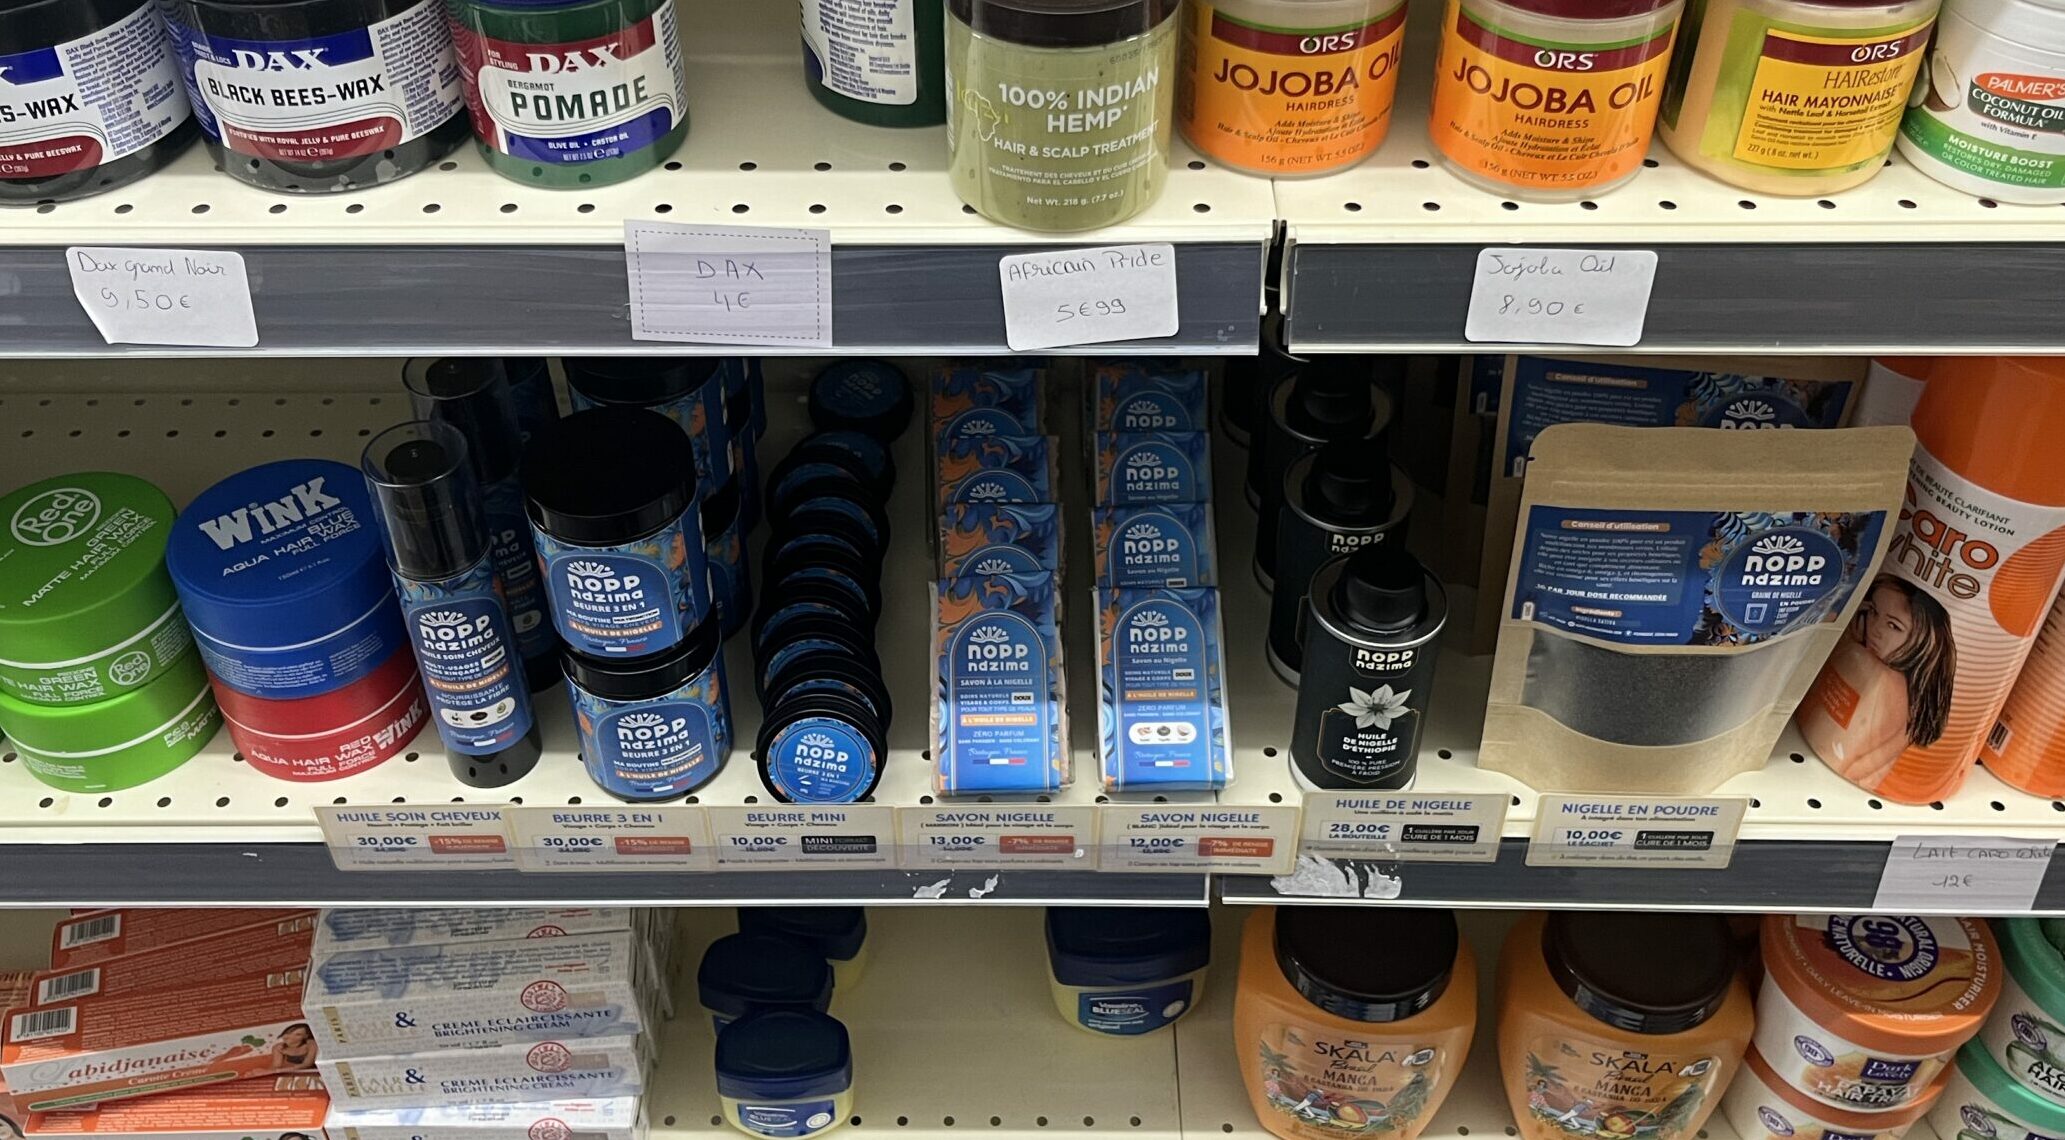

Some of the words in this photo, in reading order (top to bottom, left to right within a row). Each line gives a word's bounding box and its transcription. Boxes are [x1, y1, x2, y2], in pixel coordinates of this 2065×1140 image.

[1300, 32, 1355, 54] ORS
[1851, 40, 1901, 62] ORS
[232, 48, 330, 72] DAX
[490, 59, 518, 70] STYLING
[526, 42, 620, 74] DAX
[1534, 50, 1594, 70] ORS
[1214, 58, 1360, 97] JOJOBA
[1368, 45, 1400, 81] OIL
[1823, 64, 1901, 89] HAIRestore
[207, 77, 265, 105] BLACK
[271, 74, 384, 106] BEES-WAX
[507, 79, 554, 91] BERGAMOT
[999, 83, 1068, 110] 100%
[1078, 66, 1159, 110] INDIAN
[1453, 57, 1596, 115] JOJOBA
[1608, 73, 1653, 110] OIL
[1987, 76, 2065, 97] PALMER'S
[511, 75, 648, 121] POMADE
[1286, 97, 1355, 111] HAIRDRESS
[1762, 89, 1799, 107] HAIR
[1804, 86, 1897, 109] MAYONNAISE
[1972, 88, 2041, 116] COCONUT
[2042, 108, 2064, 120] OIL
[1514, 113, 1589, 129] HAIRDRESS
[1983, 104, 2044, 128] FORMULA
[994, 137, 1025, 155] HAIR
[1029, 145, 1038, 157] &
[1042, 147, 1089, 158] SCALP
[1093, 120, 1159, 155] TREATMENT
[1949, 135, 2008, 161] MOISTURE
[2010, 156, 2054, 169] BOOST
[1954, 158, 1983, 172] COLOR
[1985, 169, 2023, 182] TREATED
[2024, 175, 2047, 184] HAIR
[77, 251, 118, 272] Dax
[185, 257, 227, 276] Noir
[1102, 249, 1166, 271] Pride
[1580, 254, 1616, 273] Oil
[696, 258, 764, 282] DAX
[714, 290, 750, 312] 4€
[1056, 297, 1126, 323] 5€99
[1125, 414, 1177, 428] nopp
[1126, 466, 1179, 481] nopp
[1126, 480, 1180, 491] ndzima
[17, 493, 76, 533] Red
[42, 499, 94, 542] One
[306, 511, 354, 535] BLUE
[222, 554, 270, 577] AQUA
[273, 536, 315, 556] HAIR
[318, 519, 357, 538] WAX
[1124, 538, 1180, 554] nopp
[1332, 533, 1385, 546] nopp
[1124, 553, 1180, 565] ndzima
[1745, 555, 1826, 572] nopp
[22, 570, 72, 606] MATTE
[567, 573, 641, 592] nopp
[1741, 573, 1823, 586] ndzima
[570, 589, 644, 602] ndzima
[419, 615, 490, 641] nopp
[1130, 627, 1187, 643] nopp
[424, 628, 494, 651] ndzima
[1130, 642, 1188, 653] ndzima
[968, 644, 1029, 660] nopp
[1357, 650, 1413, 662] nopp
[968, 660, 1029, 672] ndzima
[1356, 660, 1412, 671] ndzima
[1004, 678, 1033, 686] NIGELLE
[616, 717, 687, 740] nopp
[339, 735, 372, 752] RED
[620, 729, 689, 750] ndzima
[1359, 737, 1398, 746] NIGELLE
[250, 750, 289, 767] AQUA
[292, 756, 331, 767] HAIR
[335, 743, 374, 762] WAX
[796, 744, 848, 762] nopp
[794, 756, 847, 772] ndzima
[1336, 799, 1381, 809] HUILE
[1386, 800, 1405, 809] DE
[1412, 801, 1473, 810] NIGELLE
[1561, 803, 1623, 814] NIGELLE
[1627, 805, 1648, 814] EN
[1653, 805, 1719, 816] POUDRE
[336, 813, 382, 822] HUILE
[385, 813, 426, 822] SOIN
[430, 812, 501, 821] CHEVEUX
[552, 814, 612, 823] BEURRE
[617, 814, 627, 823] 3
[632, 814, 651, 823] EN
[747, 813, 805, 822] BEURRE
[811, 813, 846, 822] MINI
[936, 813, 990, 822] SAVON
[996, 813, 1054, 822] NIGELLE
[1141, 813, 1195, 823] SAVON
[1201, 813, 1260, 823] NIGELLE
[1330, 823, 1390, 833] 28,00€
[1566, 830, 1623, 840] 10,00€
[357, 836, 417, 846] 30,00€
[434, 837, 462, 845] -15%
[543, 837, 603, 847] 30,00€
[731, 837, 787, 846] 10,00€
[930, 836, 985, 845] 13,00€
[1007, 837, 1028, 845] -7%
[1130, 838, 1185, 848] 12,00€
[1953, 944, 1988, 1010] MOISTURISER
[434, 1025, 524, 1038] BRIGHTENING
[526, 1020, 570, 1031] CREAM
[1314, 1041, 1395, 1063] SKALA
[1590, 1052, 1673, 1073] SKALA
[1872, 1062, 1912, 1071] Dark
[1323, 1070, 1377, 1085] MANGA
[1867, 1067, 1909, 1078] Lovely
[442, 1083, 532, 1094] BRIGHTENING
[534, 1080, 575, 1090] CREAM
[1595, 1080, 1650, 1097] MANGA
